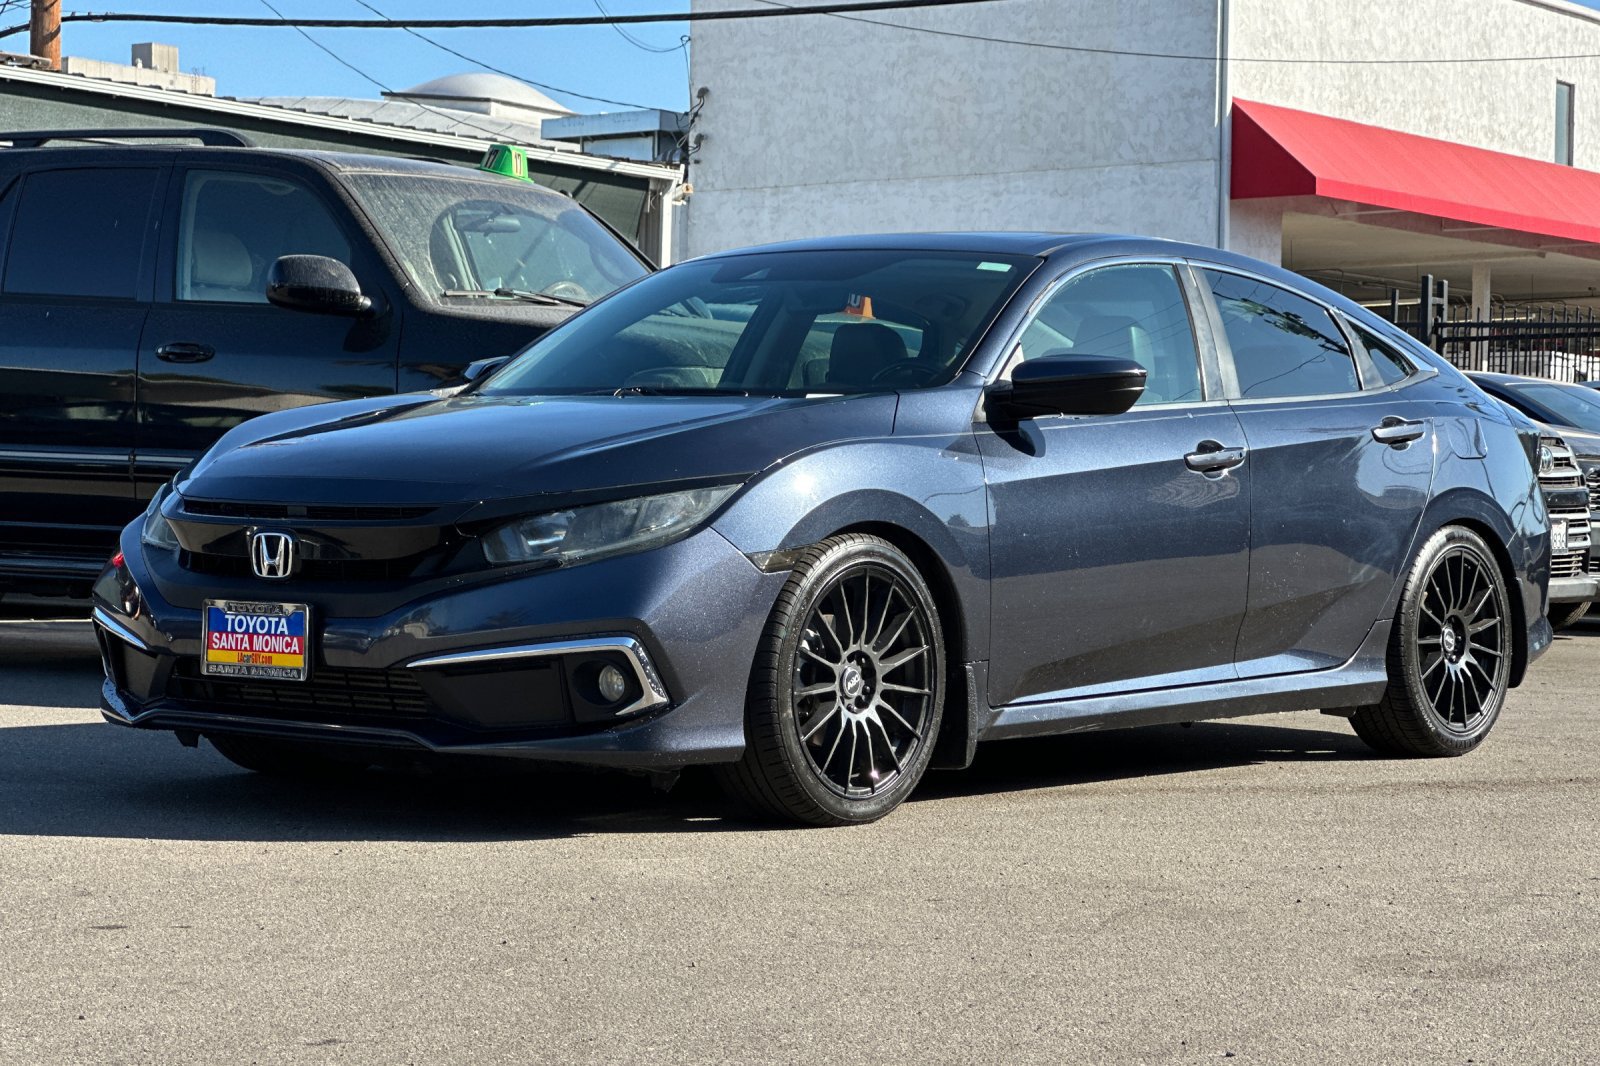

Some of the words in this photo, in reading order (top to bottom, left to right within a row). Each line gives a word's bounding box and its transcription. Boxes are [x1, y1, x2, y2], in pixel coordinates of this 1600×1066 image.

[230, 602, 282, 614] TOYOTA
[225, 615, 288, 635] TOYOTA
[212, 632, 250, 650] SANTA
[253, 635, 300, 653] MONICA
[208, 664, 248, 675] SANTA
[251, 666, 299, 678] MONICA
